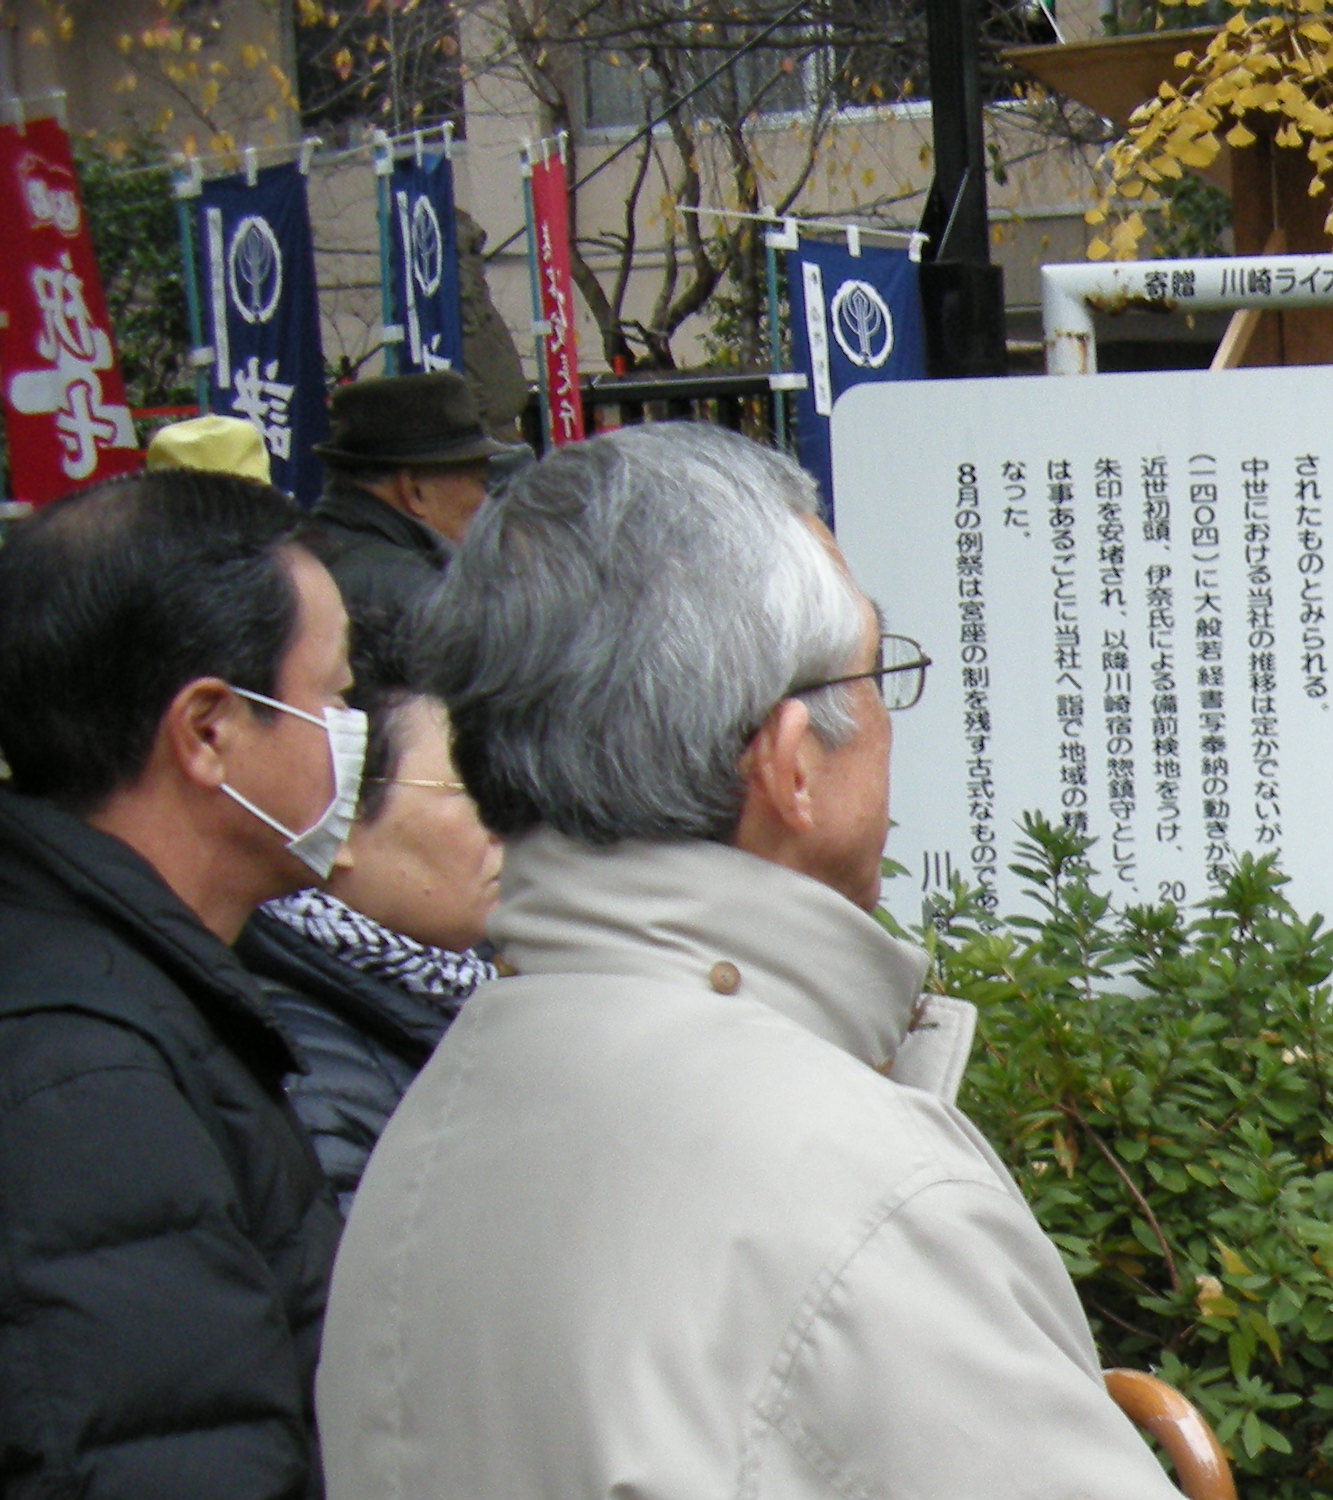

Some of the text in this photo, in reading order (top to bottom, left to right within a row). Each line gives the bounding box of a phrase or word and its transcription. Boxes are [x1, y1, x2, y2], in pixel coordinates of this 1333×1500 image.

[1143, 269, 1196, 299] 寄贈
[1000, 459, 1031, 538] なった。
[1294, 453, 1330, 712] されたものとみられる。
